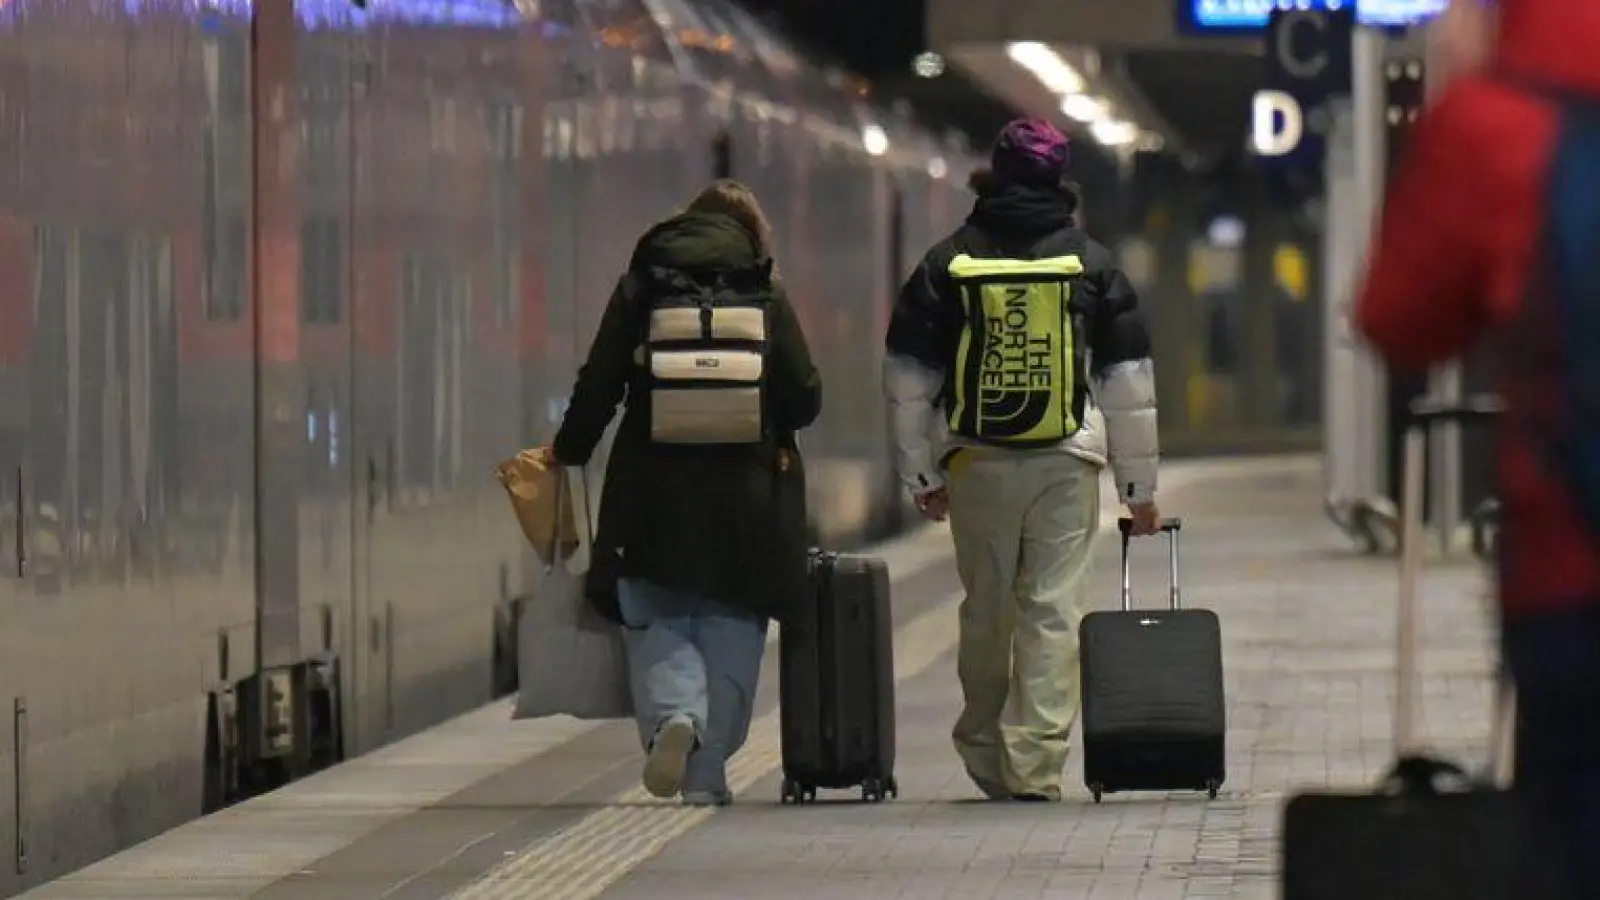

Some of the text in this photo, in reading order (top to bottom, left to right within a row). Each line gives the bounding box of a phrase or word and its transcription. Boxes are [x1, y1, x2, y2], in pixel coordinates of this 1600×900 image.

[1278, 10, 1328, 77] C
[1252, 89, 1303, 156] D
[982, 318, 1003, 387] FACE
[1004, 288, 1028, 387] NORTH
[1029, 333, 1052, 387] THE
